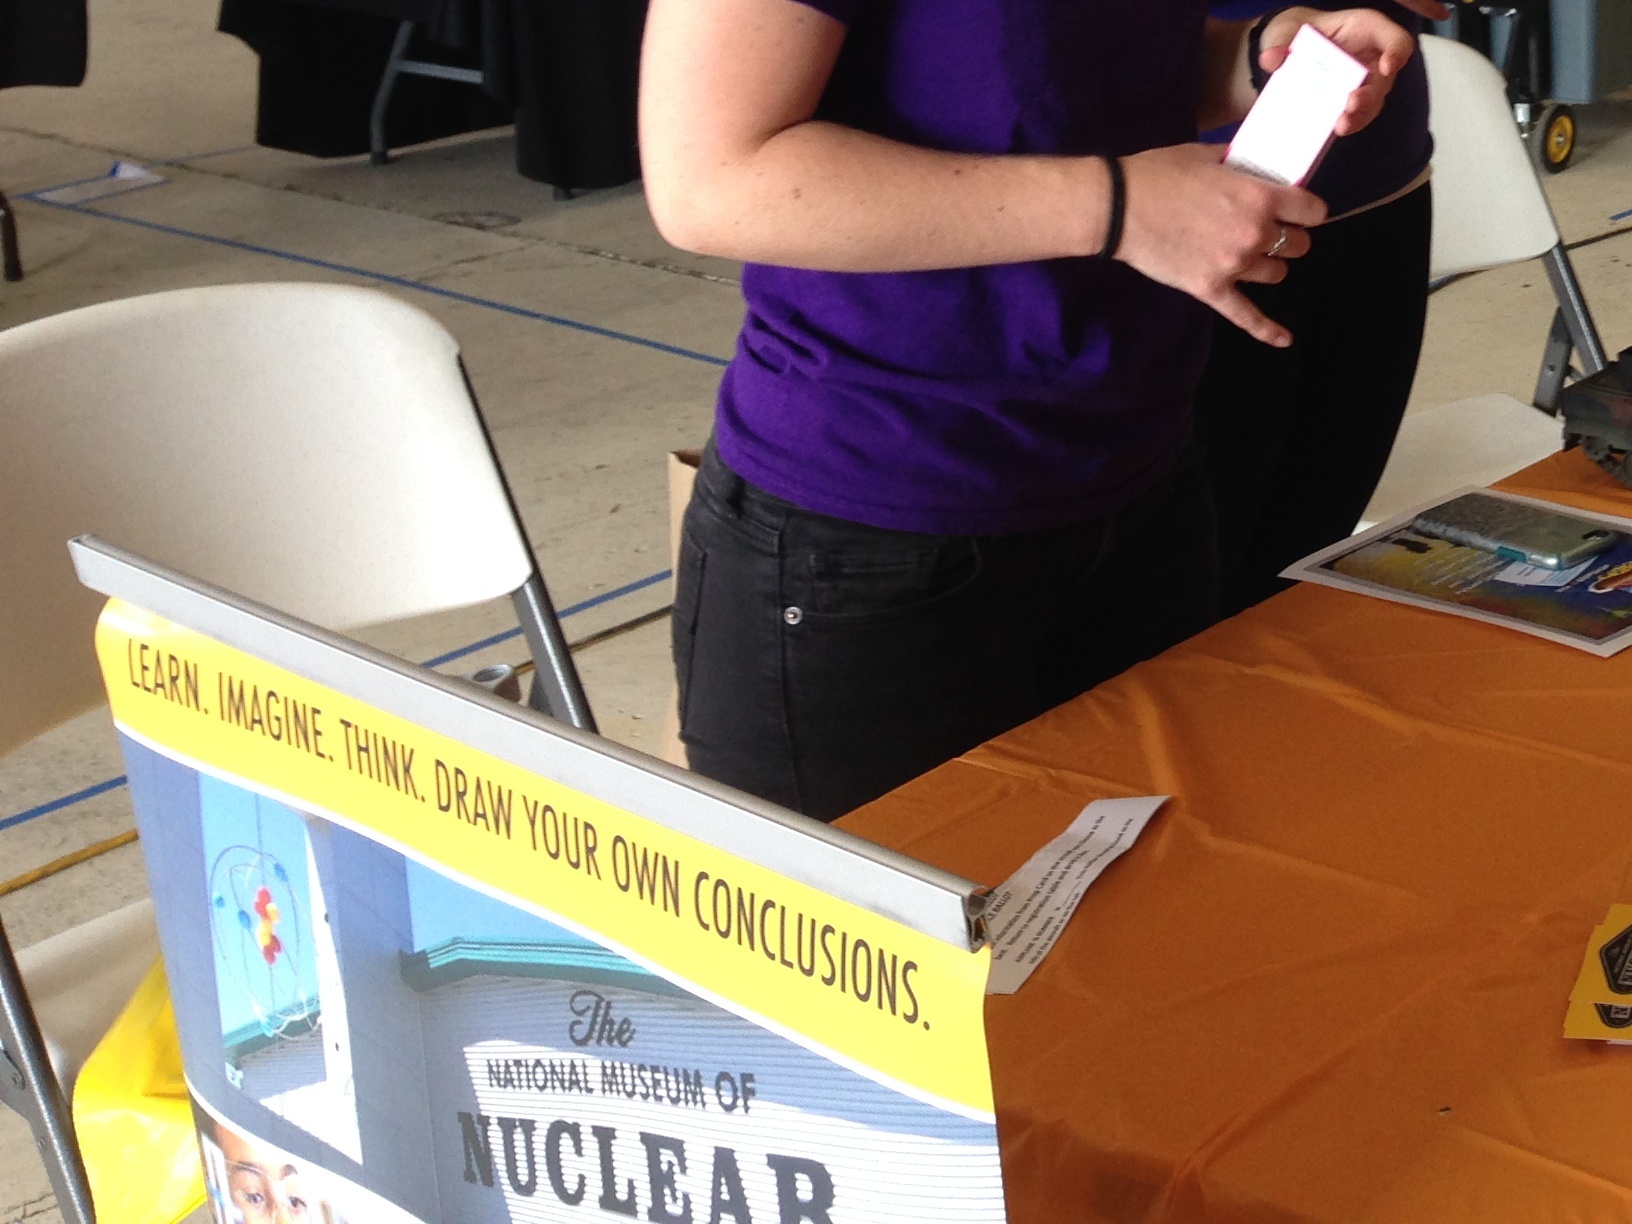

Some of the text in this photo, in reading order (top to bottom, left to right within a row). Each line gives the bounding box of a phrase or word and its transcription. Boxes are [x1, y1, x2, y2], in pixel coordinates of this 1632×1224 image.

[128, 638, 930, 1030] LEARN. IMAGINE. THINK. DRAW YOUR OWN CONCLUSIONS.
[569, 990, 636, 1047] The
[486, 1059, 757, 1114] NATIONAL MUSEUM OF
[457, 1111, 836, 1224] NUCLEAR
